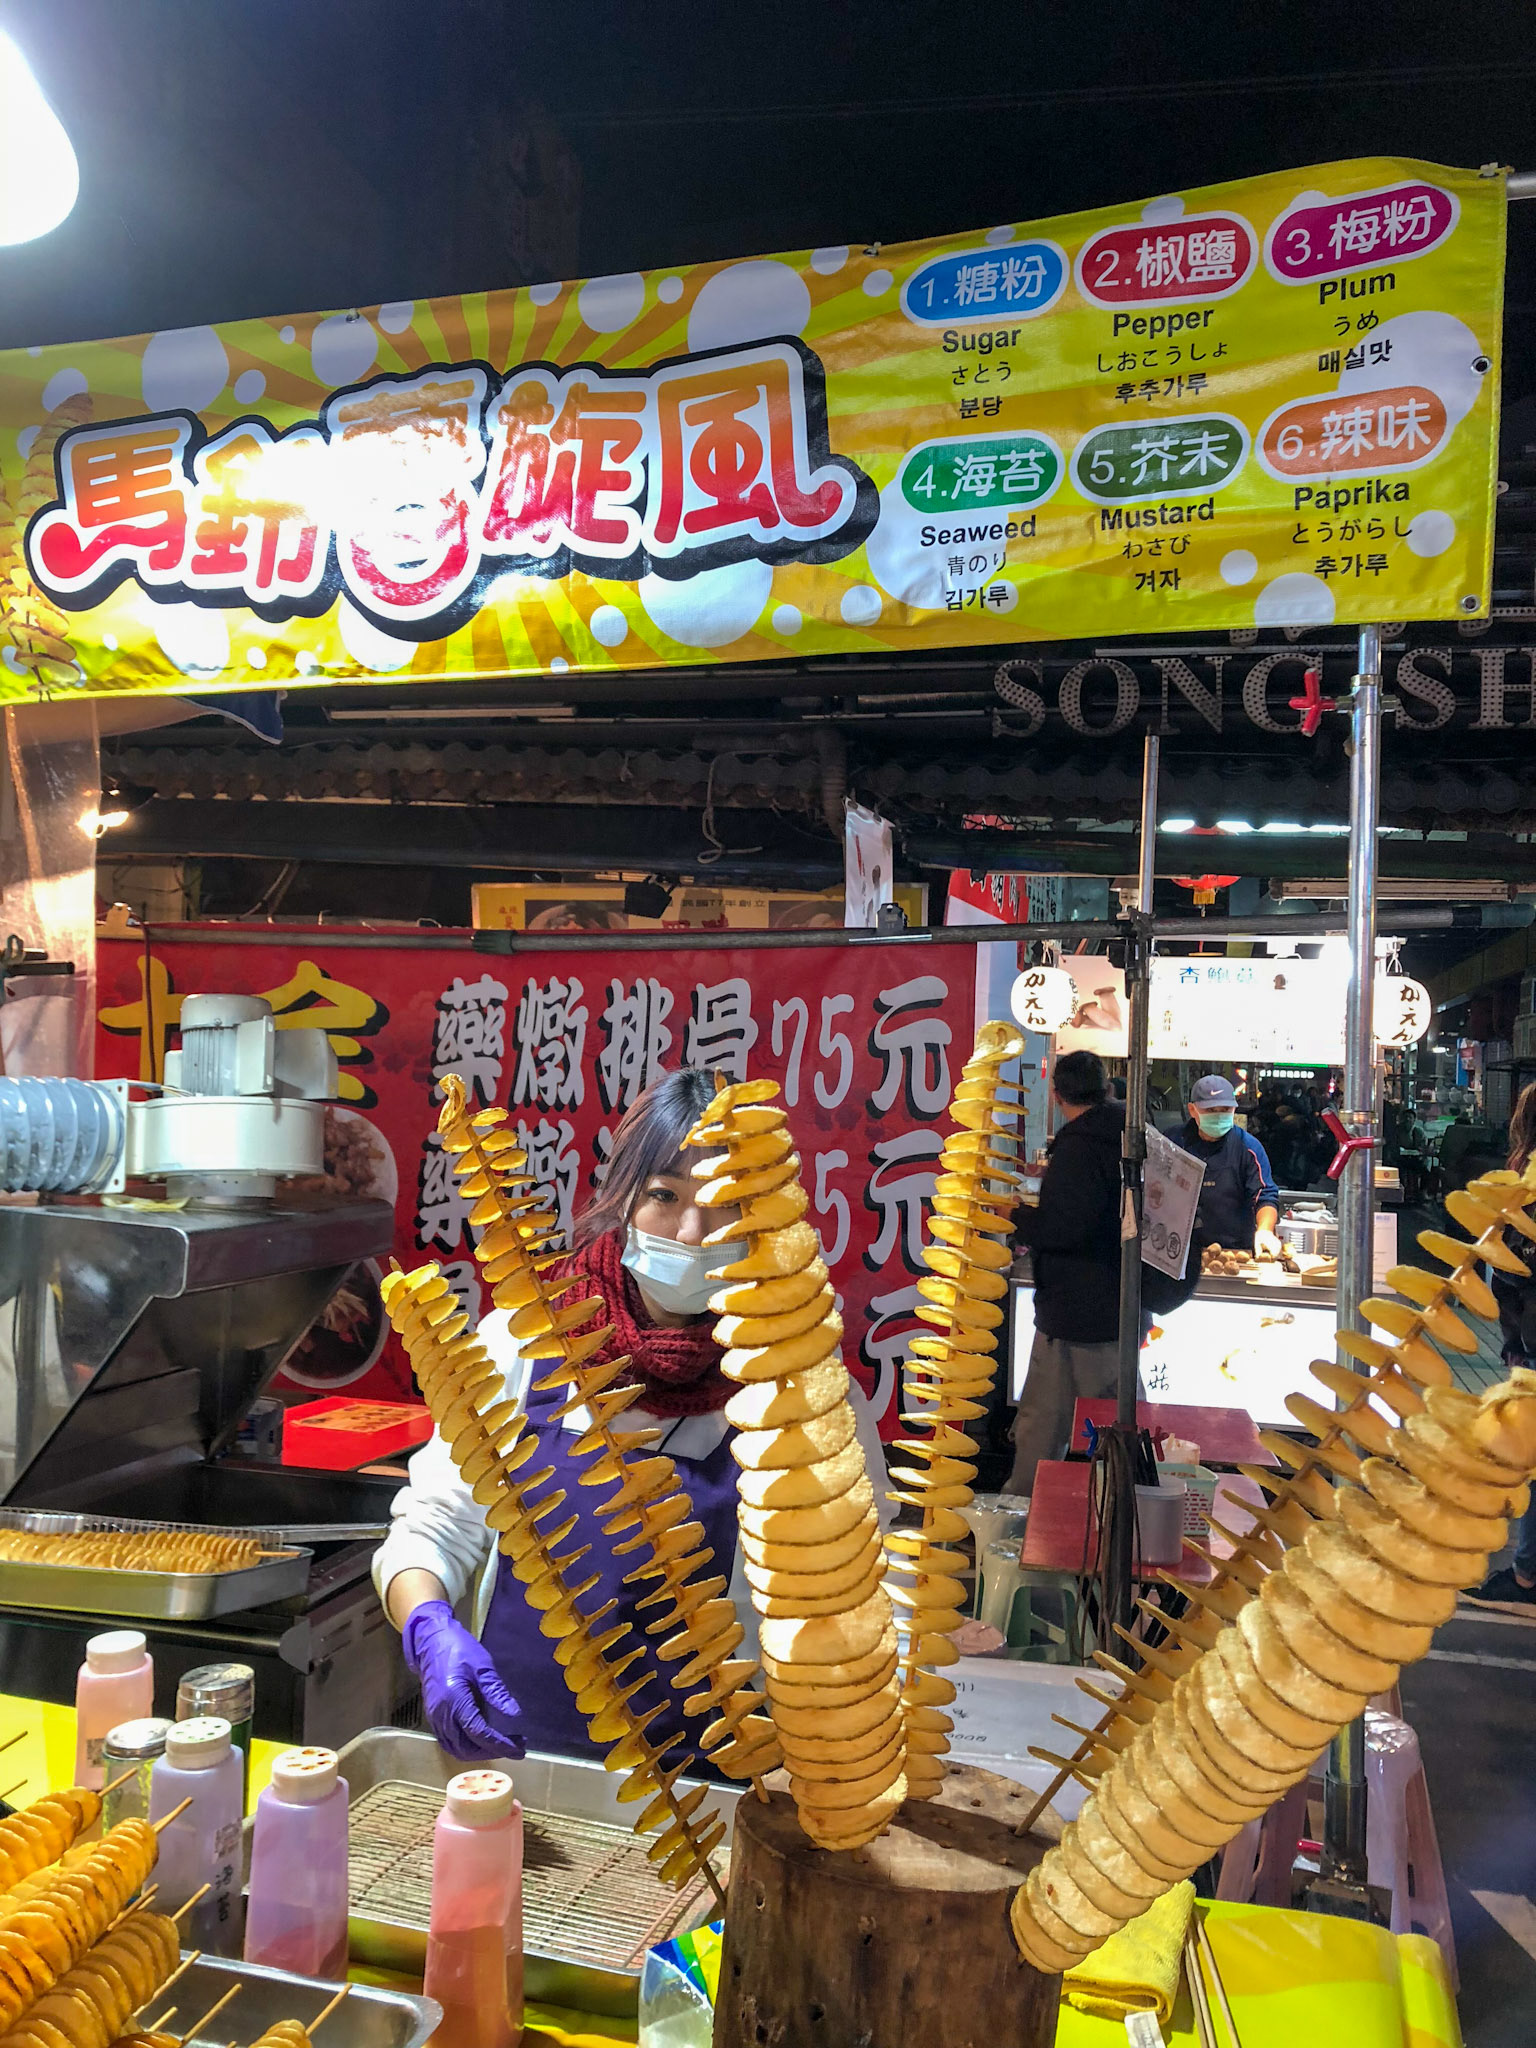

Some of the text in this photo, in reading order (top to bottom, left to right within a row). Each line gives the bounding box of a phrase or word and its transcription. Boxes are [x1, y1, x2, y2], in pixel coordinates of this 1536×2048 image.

[1285, 195, 1437, 265] 3.梅粉
[1094, 229, 1237, 289] 2.椒鹽
[920, 255, 1047, 307] 1.糖粉
[1319, 272, 1396, 305] Plum
[1113, 310, 1215, 339] Pepper
[1334, 310, 1379, 336] うめ
[942, 329, 1022, 355] Sugar
[1097, 342, 1228, 373] しおこうしょ
[1318, 339, 1393, 373] 매실맛
[952, 361, 1012, 385] さとう
[1115, 372, 1209, 404] 후추가루
[959, 395, 1003, 419] 분당
[1277, 398, 1431, 461] 6.辣味
[912, 448, 1047, 500] 4.海苔
[1089, 431, 1230, 486] 5.芥末
[1294, 479, 1411, 513] Paprika
[1101, 497, 1214, 531] Mustard
[920, 514, 1036, 547] Seaweed
[1292, 516, 1413, 544] とうがらし
[1122, 533, 1191, 559] わさび
[947, 551, 1007, 577] 青のり
[1135, 567, 1181, 592] 겨자
[1314, 553, 1389, 580] 추가루
[945, 585, 1009, 611] 김가루
